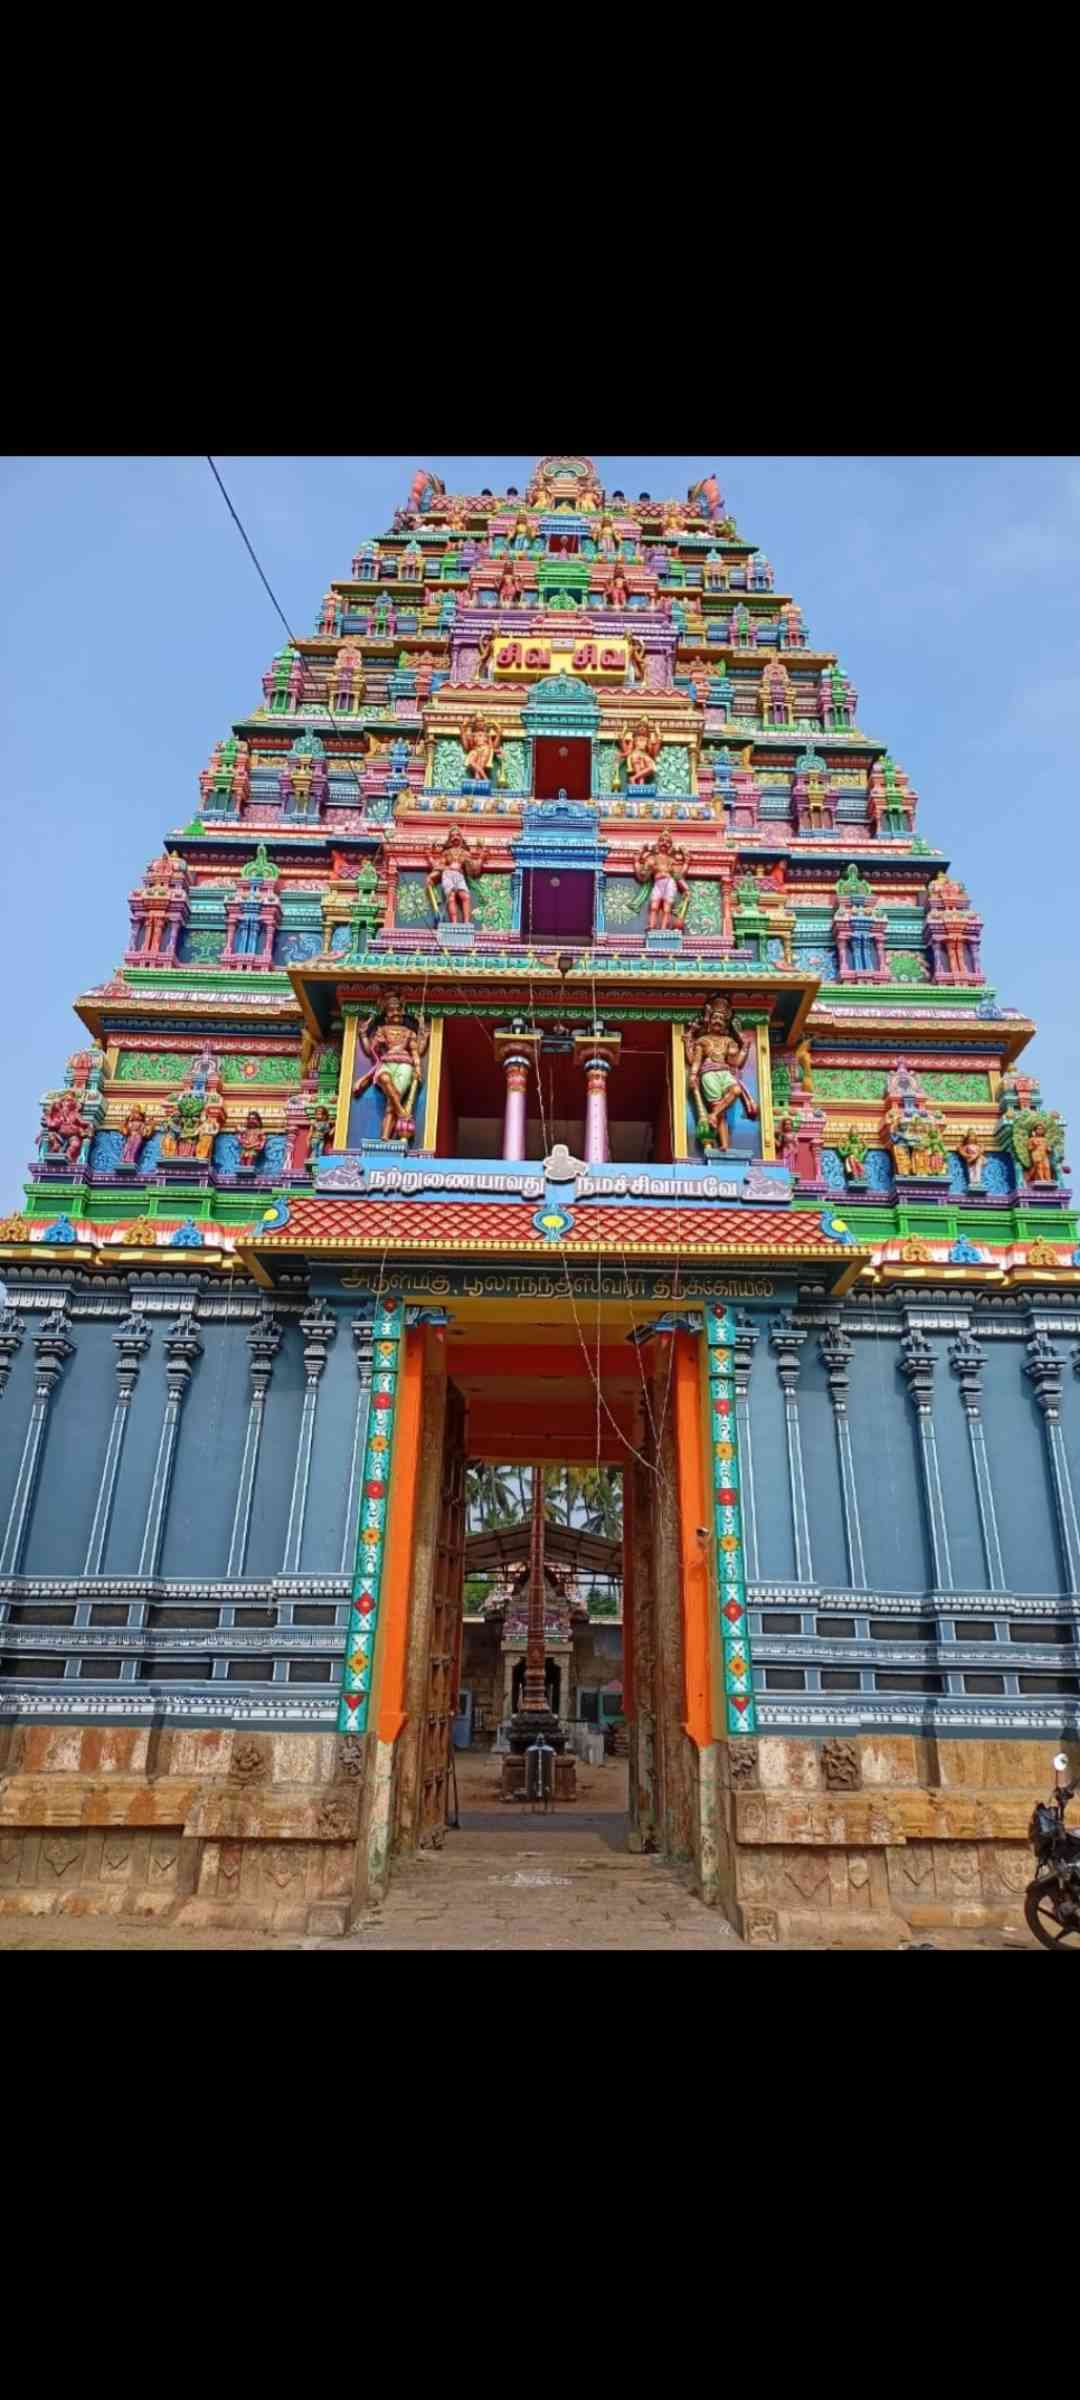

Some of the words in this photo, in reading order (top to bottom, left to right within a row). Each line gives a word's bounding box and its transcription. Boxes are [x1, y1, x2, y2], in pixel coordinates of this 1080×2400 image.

[497, 642, 550, 668] சிவ
[573, 643, 626, 670] சிவ
[368, 1166, 545, 1198] நற்றுணையாவது
[575, 1174, 738, 1197] நமச்சிவாயவே
